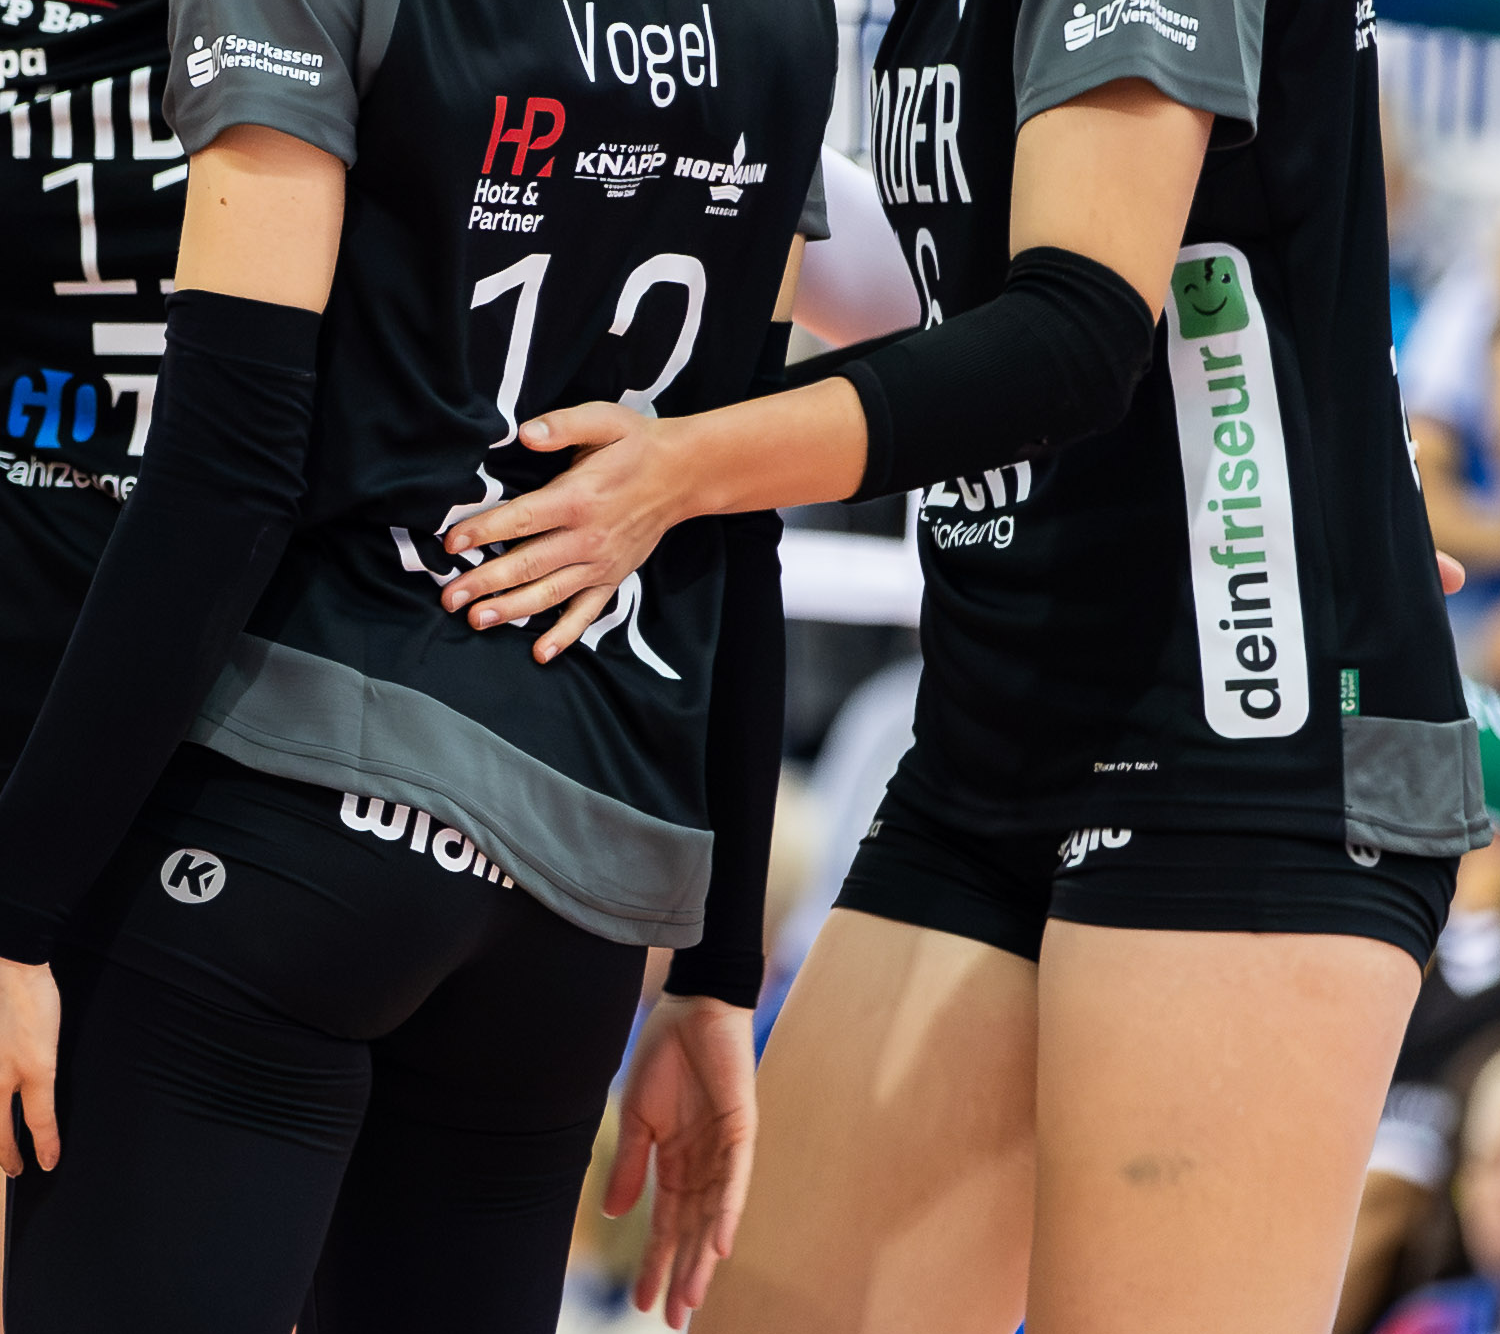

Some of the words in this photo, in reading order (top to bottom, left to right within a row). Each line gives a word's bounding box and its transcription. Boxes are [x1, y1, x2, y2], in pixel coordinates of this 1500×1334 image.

[225, 34, 324, 69] Sparkassen
[219, 52, 322, 87] Versicherung
[598, 142, 660, 153] AUTOHAUS
[574, 152, 667, 177] KNAPP
[474, 178, 518, 206] Hotz
[520, 182, 540, 207] &
[467, 205, 545, 234] Partner
[1210, 343, 1283, 720] deinfriseur
